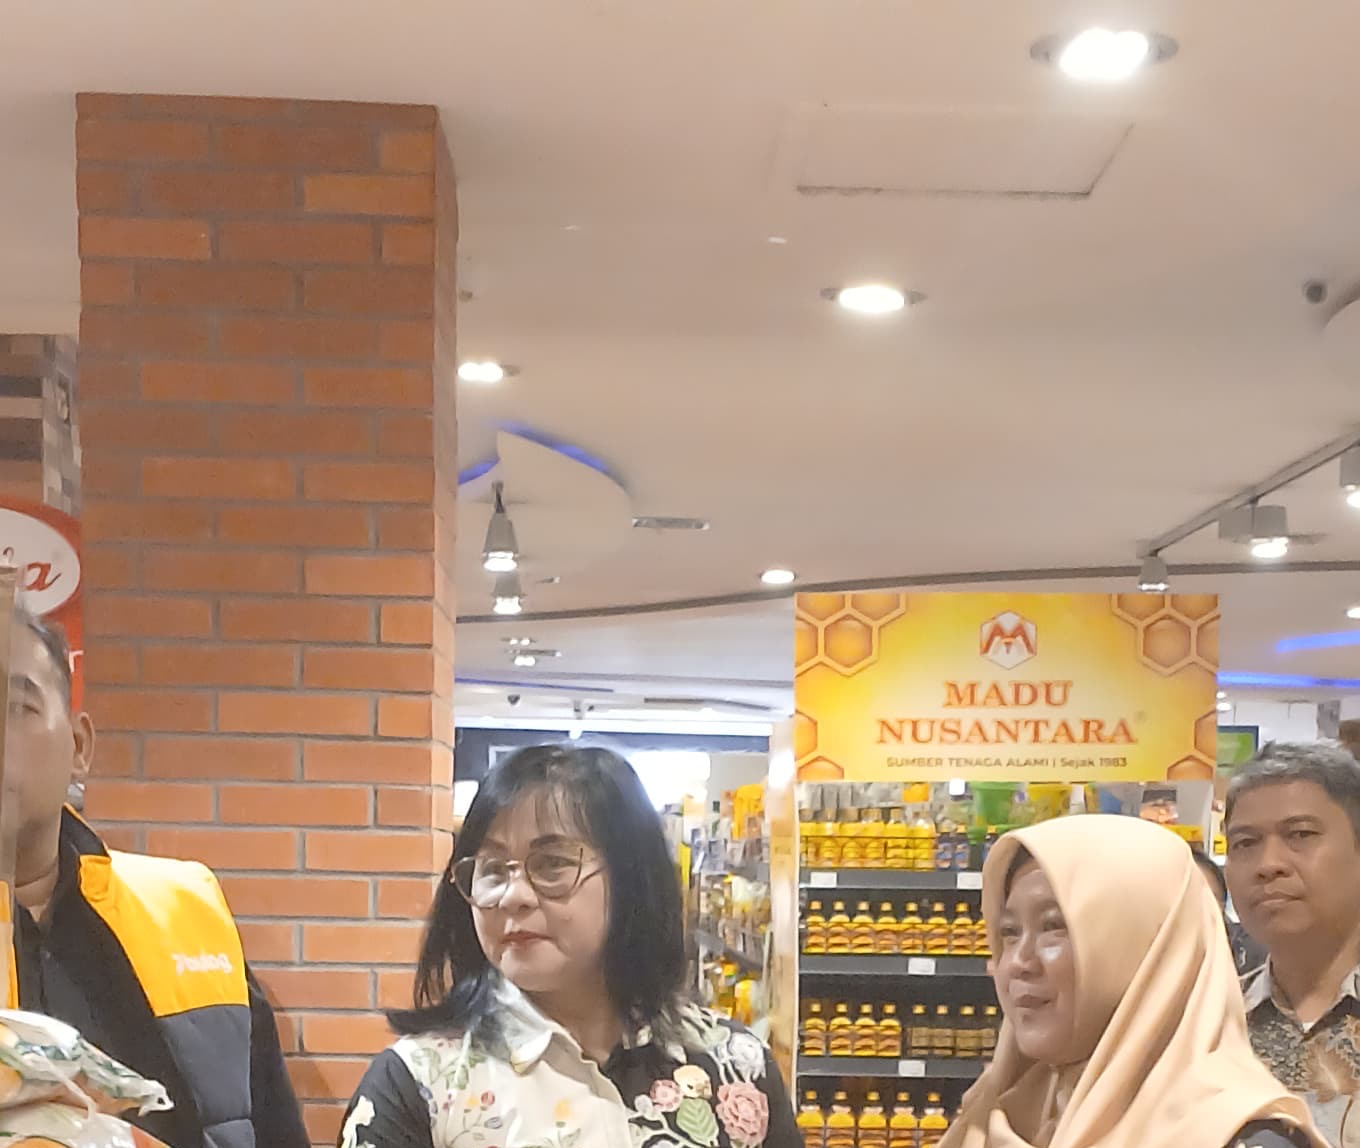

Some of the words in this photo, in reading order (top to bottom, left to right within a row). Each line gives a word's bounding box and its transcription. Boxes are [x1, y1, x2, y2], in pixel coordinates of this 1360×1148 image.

[942, 680, 1074, 708] MADU
[876, 718, 1138, 745] NUSANTARA
[886, 757, 943, 768] SUMBER
[948, 757, 1002, 768] TENAGA
[1006, 757, 1049, 768] ALAMI
[1060, 757, 1095, 769] Sejak
[1099, 757, 1128, 768] 1983
